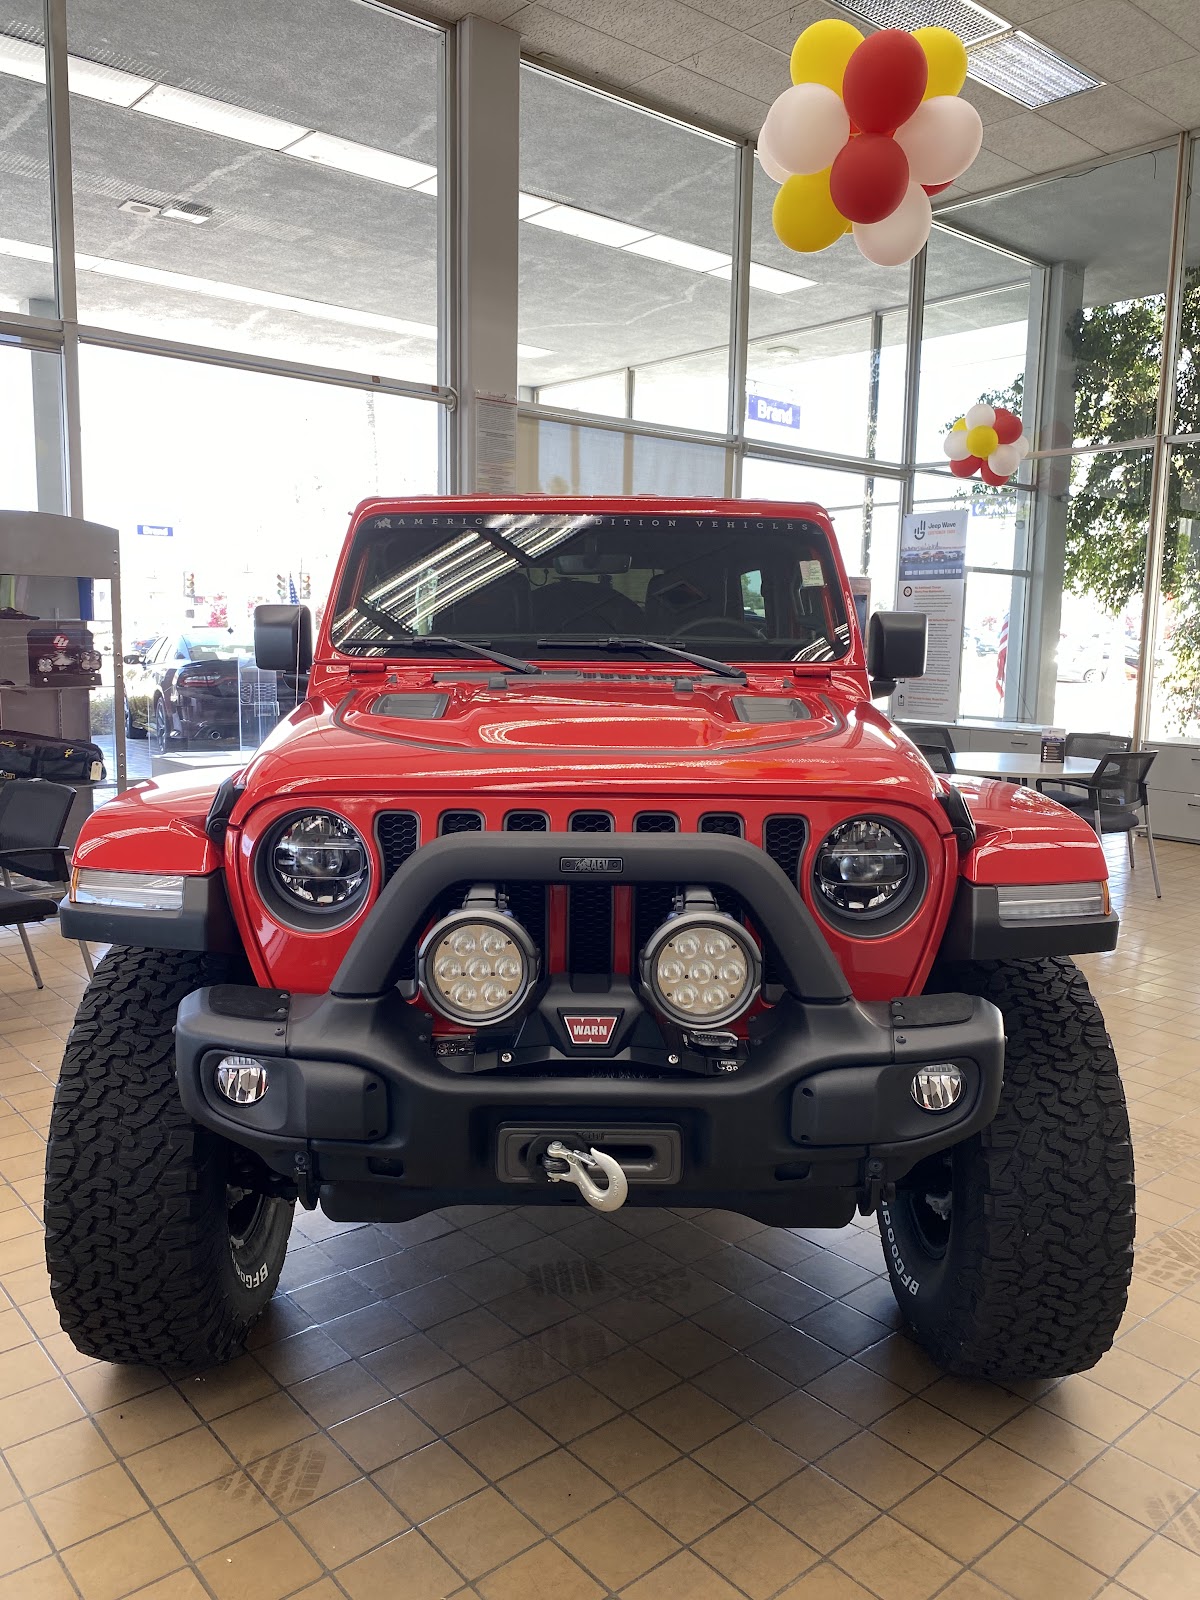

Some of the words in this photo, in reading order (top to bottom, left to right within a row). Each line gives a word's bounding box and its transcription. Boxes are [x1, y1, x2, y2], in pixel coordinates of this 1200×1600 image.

[757, 399, 793, 425] Brand
[397, 517, 514, 527] AMERICN
[695, 520, 808, 531] VEHICLES
[573, 1025, 607, 1036] WARN
